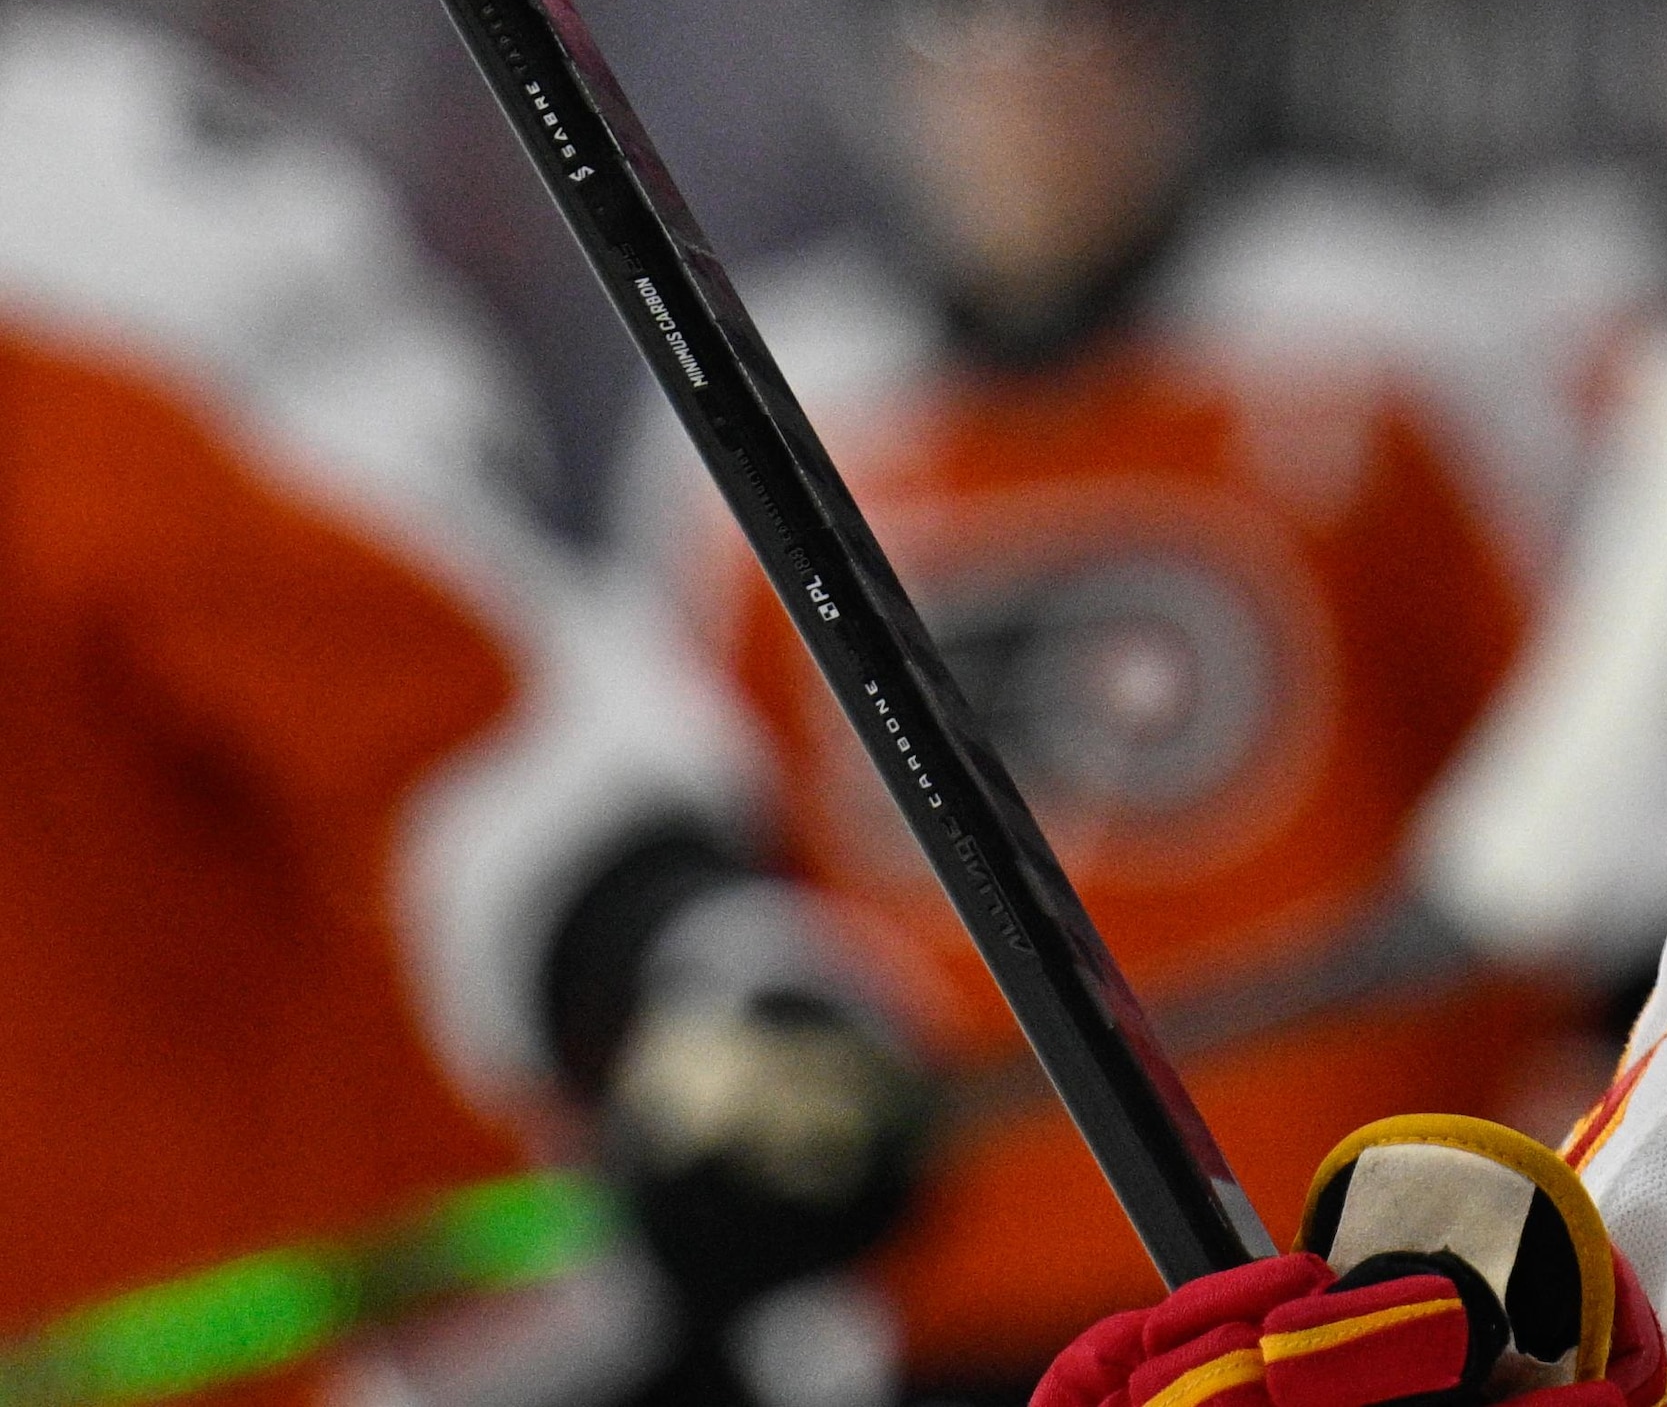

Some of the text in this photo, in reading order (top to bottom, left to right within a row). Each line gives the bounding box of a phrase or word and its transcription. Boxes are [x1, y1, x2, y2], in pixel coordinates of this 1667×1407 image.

[482, 3, 527, 74] TAPER
[525, 81, 577, 158] SABRE
[634, 276, 677, 331] CARBON
[665, 331, 708, 388] MINIMUS
[735, 447, 792, 542] CONSTRUCTION
[806, 574, 830, 603] PL
[864, 680, 942, 808] CARBONE
